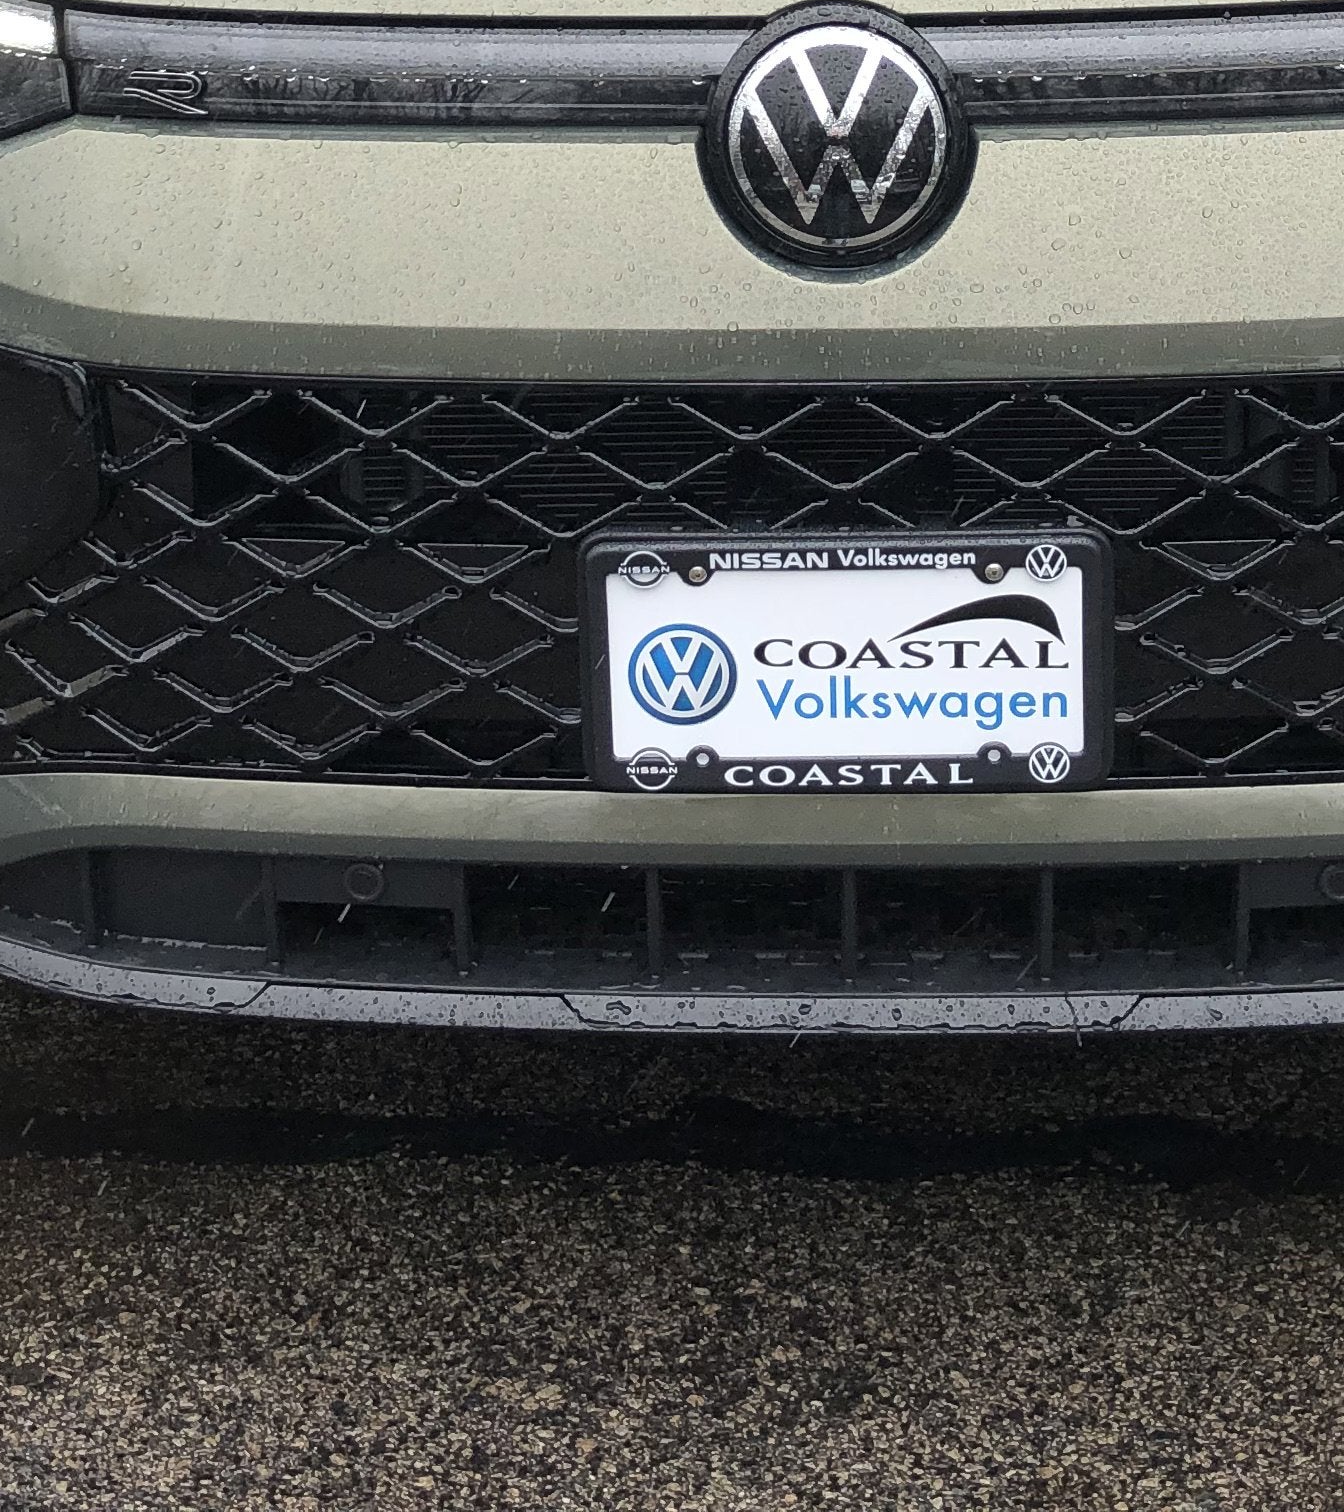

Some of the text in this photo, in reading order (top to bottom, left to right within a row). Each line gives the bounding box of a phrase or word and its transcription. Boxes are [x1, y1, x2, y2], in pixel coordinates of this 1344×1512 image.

[709, 548, 976, 570] NISSAN Volkswagen
[753, 637, 1069, 669] COASTAL
[757, 675, 1068, 731] Volkswagen
[723, 763, 975, 787] COASTAL
